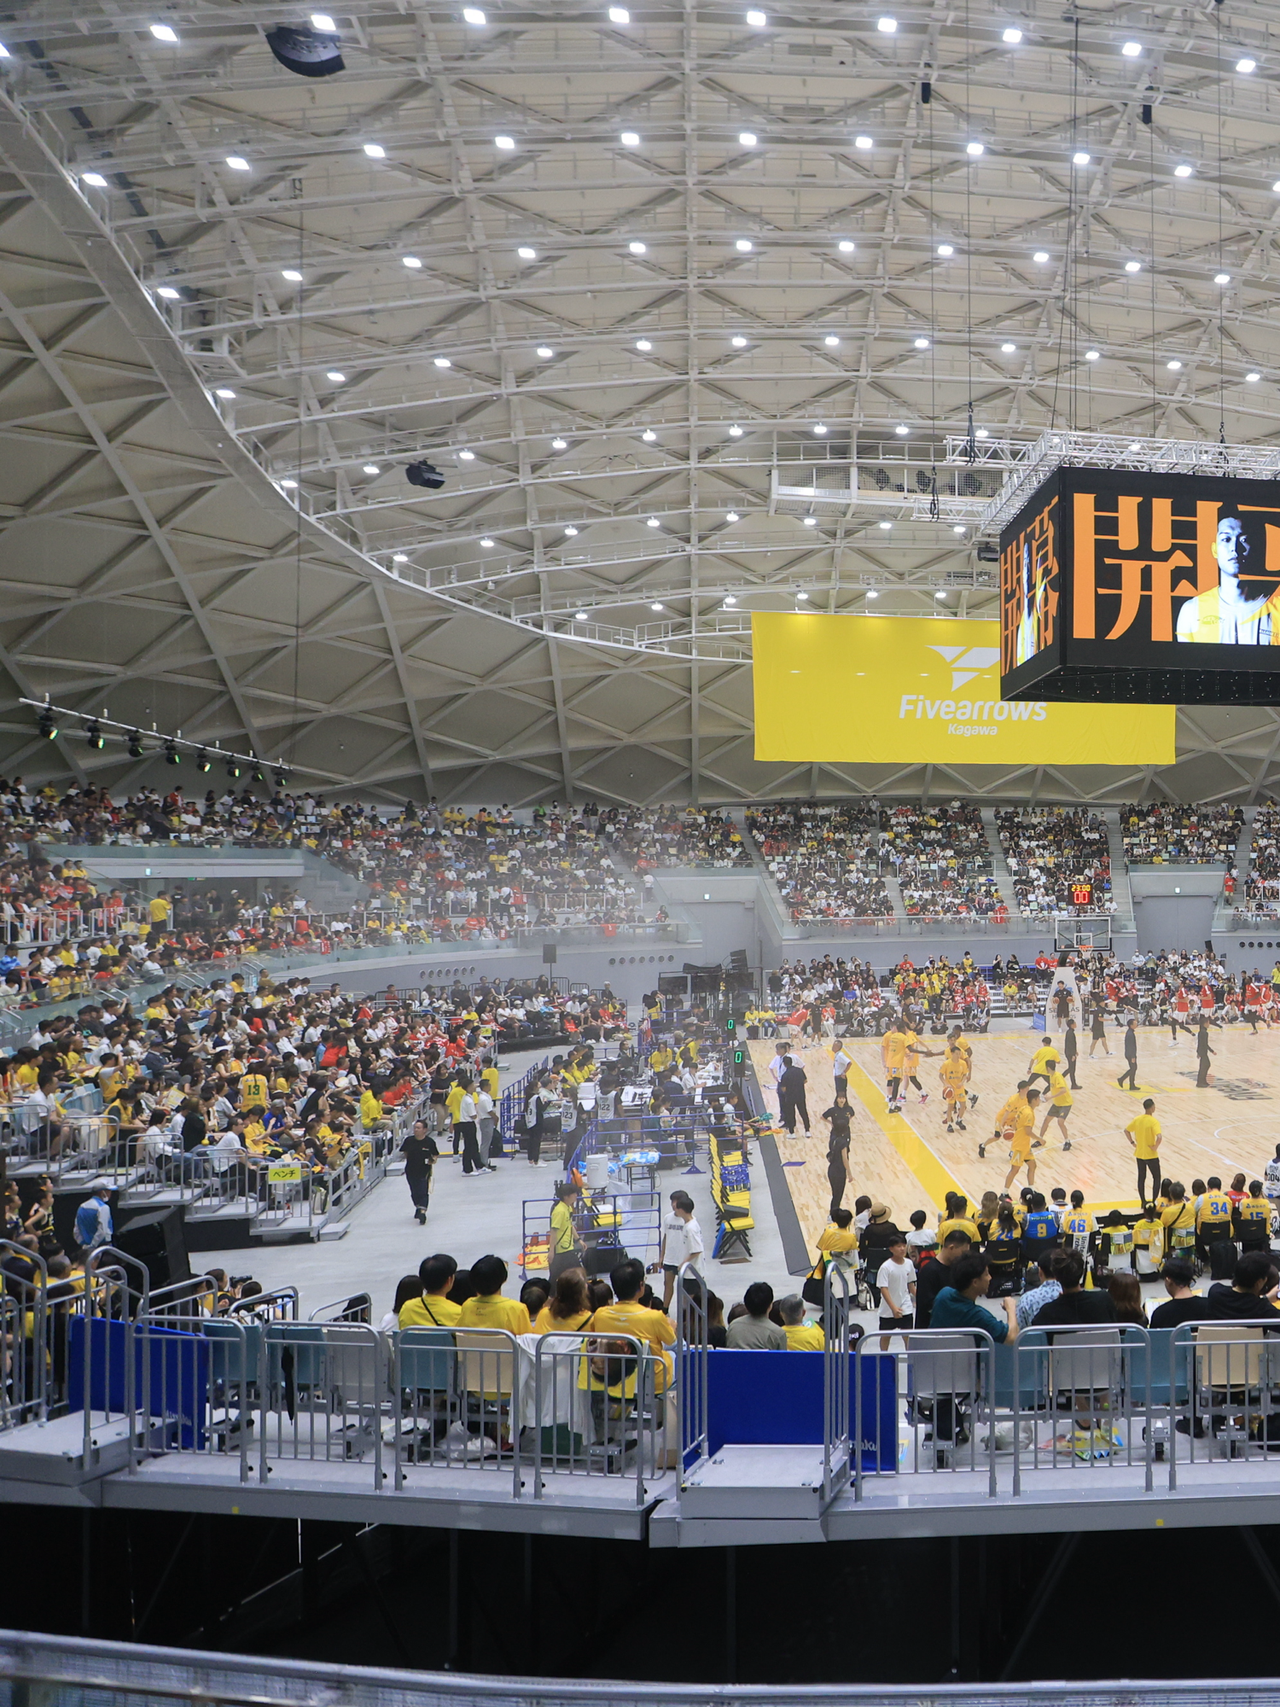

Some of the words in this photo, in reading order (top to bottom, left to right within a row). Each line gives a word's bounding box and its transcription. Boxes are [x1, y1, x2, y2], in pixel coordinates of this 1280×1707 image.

[899, 695, 1048, 721] Fivearrows
[947, 723, 998, 737] Kagawa
[1074, 891, 1088, 904] 00
[247, 1084, 261, 1096] 13
[1210, 1202, 1229, 1216] 34
[1069, 1219, 1087, 1233] 46
